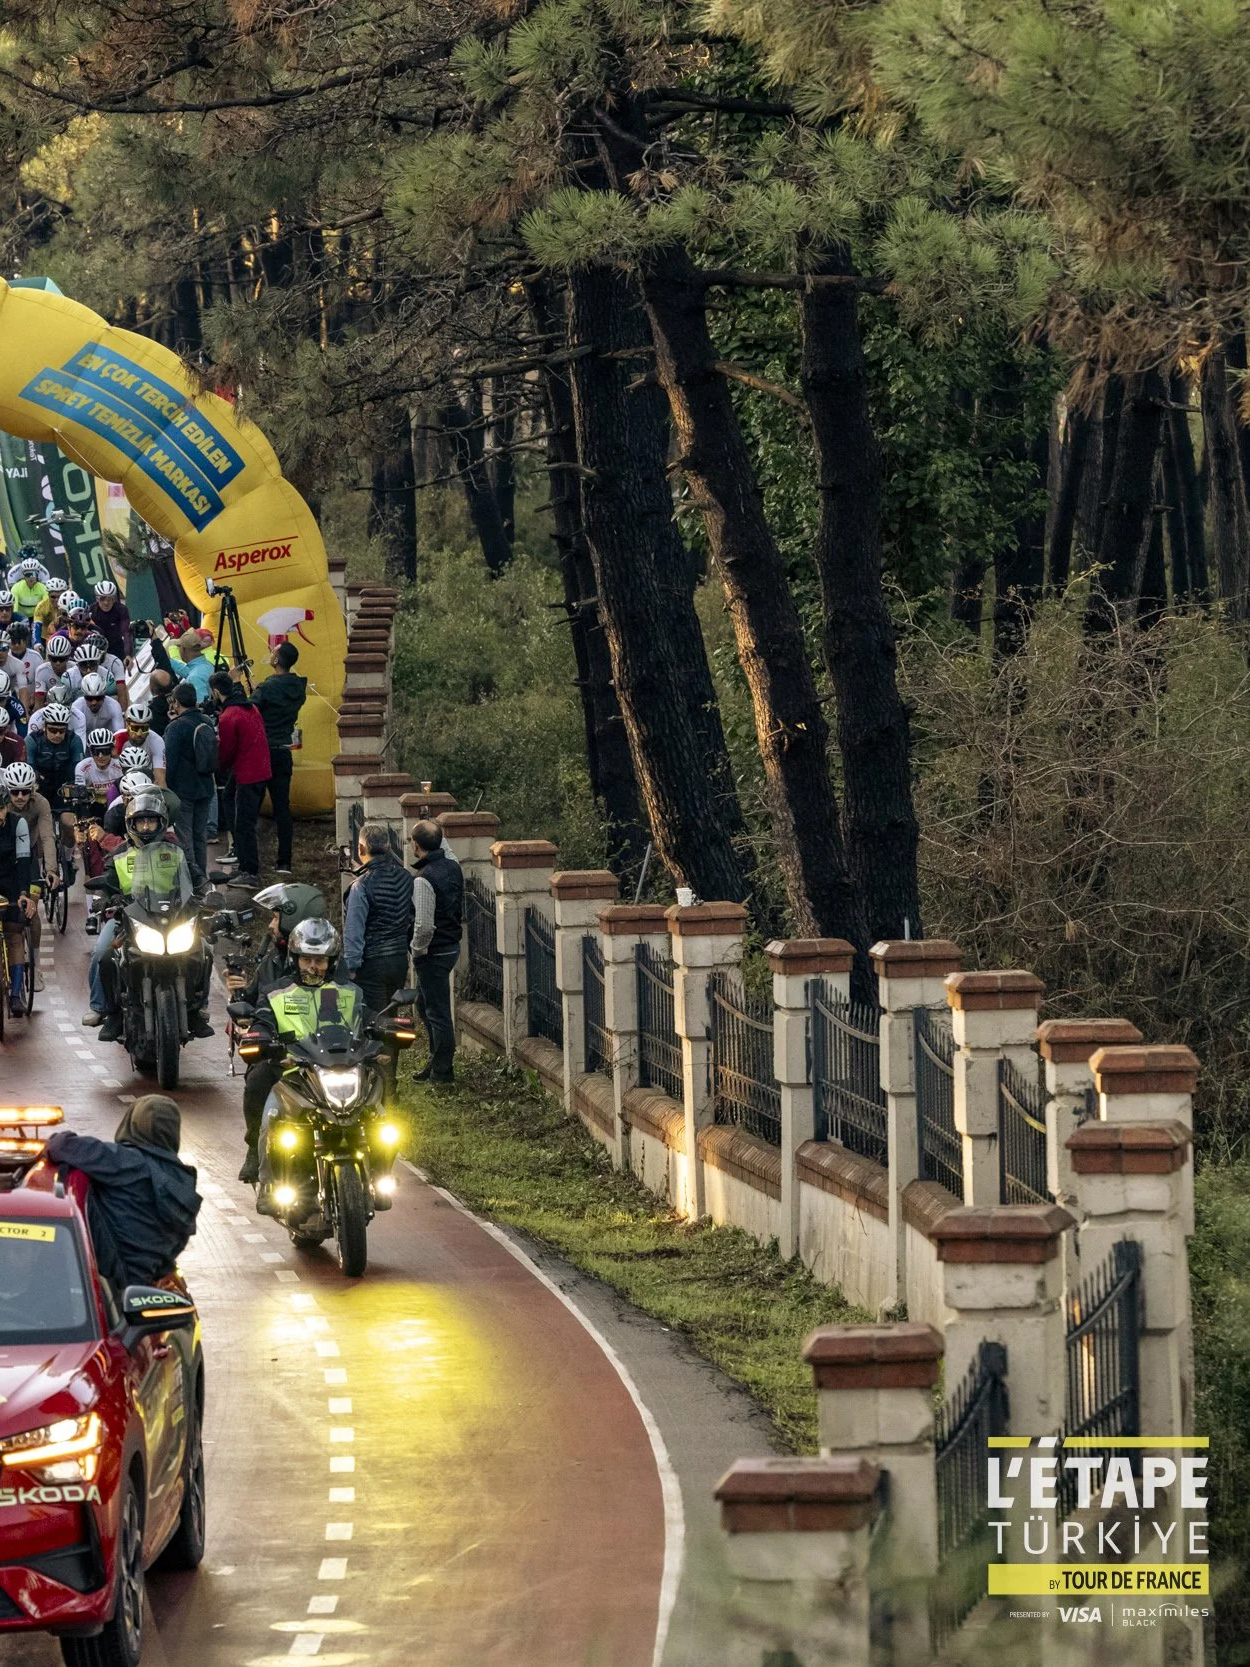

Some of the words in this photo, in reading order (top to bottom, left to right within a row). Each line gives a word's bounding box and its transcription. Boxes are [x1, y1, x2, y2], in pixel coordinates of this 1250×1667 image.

[34, 379, 93, 408] SPREY
[88, 399, 157, 456] TEMİZLİK
[150, 449, 211, 516] MARKASI
[77, 354, 101, 371] EN
[101, 363, 141, 390] ÇOK
[135, 383, 187, 428] TERCİH
[181, 421, 232, 474] EDİLEN
[214, 544, 292, 571] Asperox
[130, 1294, 184, 1307] SKODA
